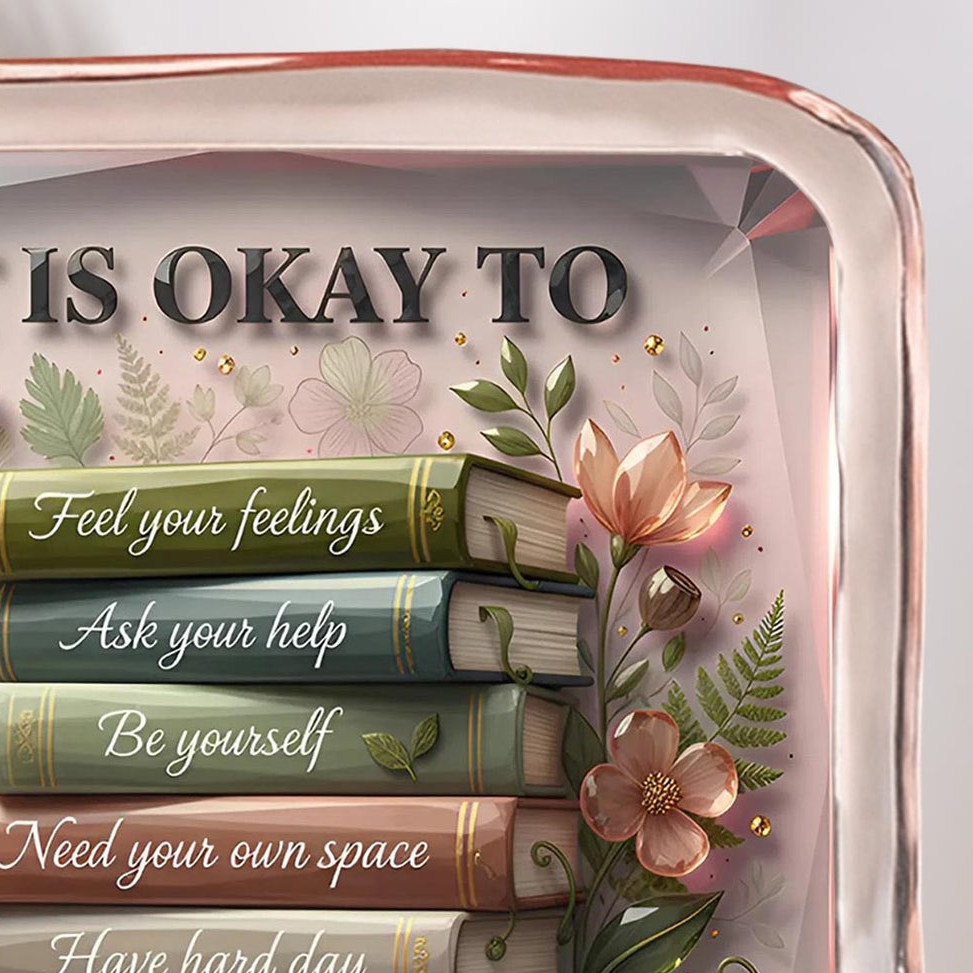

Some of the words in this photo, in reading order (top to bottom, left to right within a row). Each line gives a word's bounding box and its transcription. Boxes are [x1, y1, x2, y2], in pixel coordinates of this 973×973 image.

[22, 246, 119, 325] IS
[153, 246, 447, 325] OKAY
[477, 246, 628, 325] TO
[28, 489, 129, 542] Feel
[128, 508, 227, 555] your
[231, 487, 384, 555] feelings
[59, 601, 157, 650] Ask
[153, 619, 256, 670] your
[265, 601, 346, 669] help
[98, 709, 164, 757] Be
[162, 707, 343, 777] yourself
[115, 838, 218, 890] your
[229, 838, 310, 868] own
[318, 838, 429, 887] space
